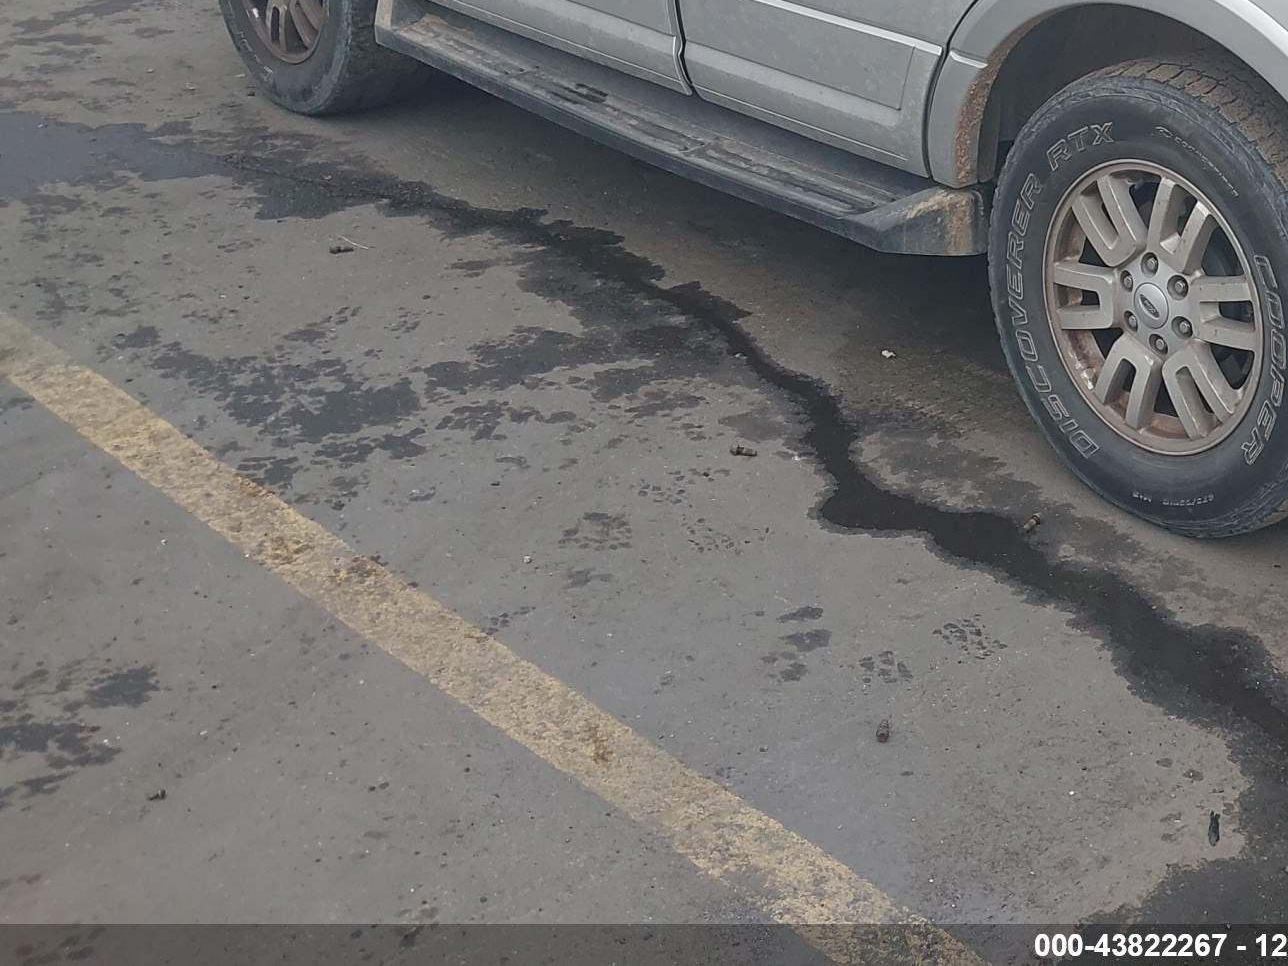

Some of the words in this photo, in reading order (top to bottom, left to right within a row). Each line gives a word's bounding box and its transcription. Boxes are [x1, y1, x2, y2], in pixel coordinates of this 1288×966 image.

[1047, 122, 1114, 170] RTX
[1006, 172, 1100, 459] DISCOVERER
[1241, 254, 1286, 465] COOPER
